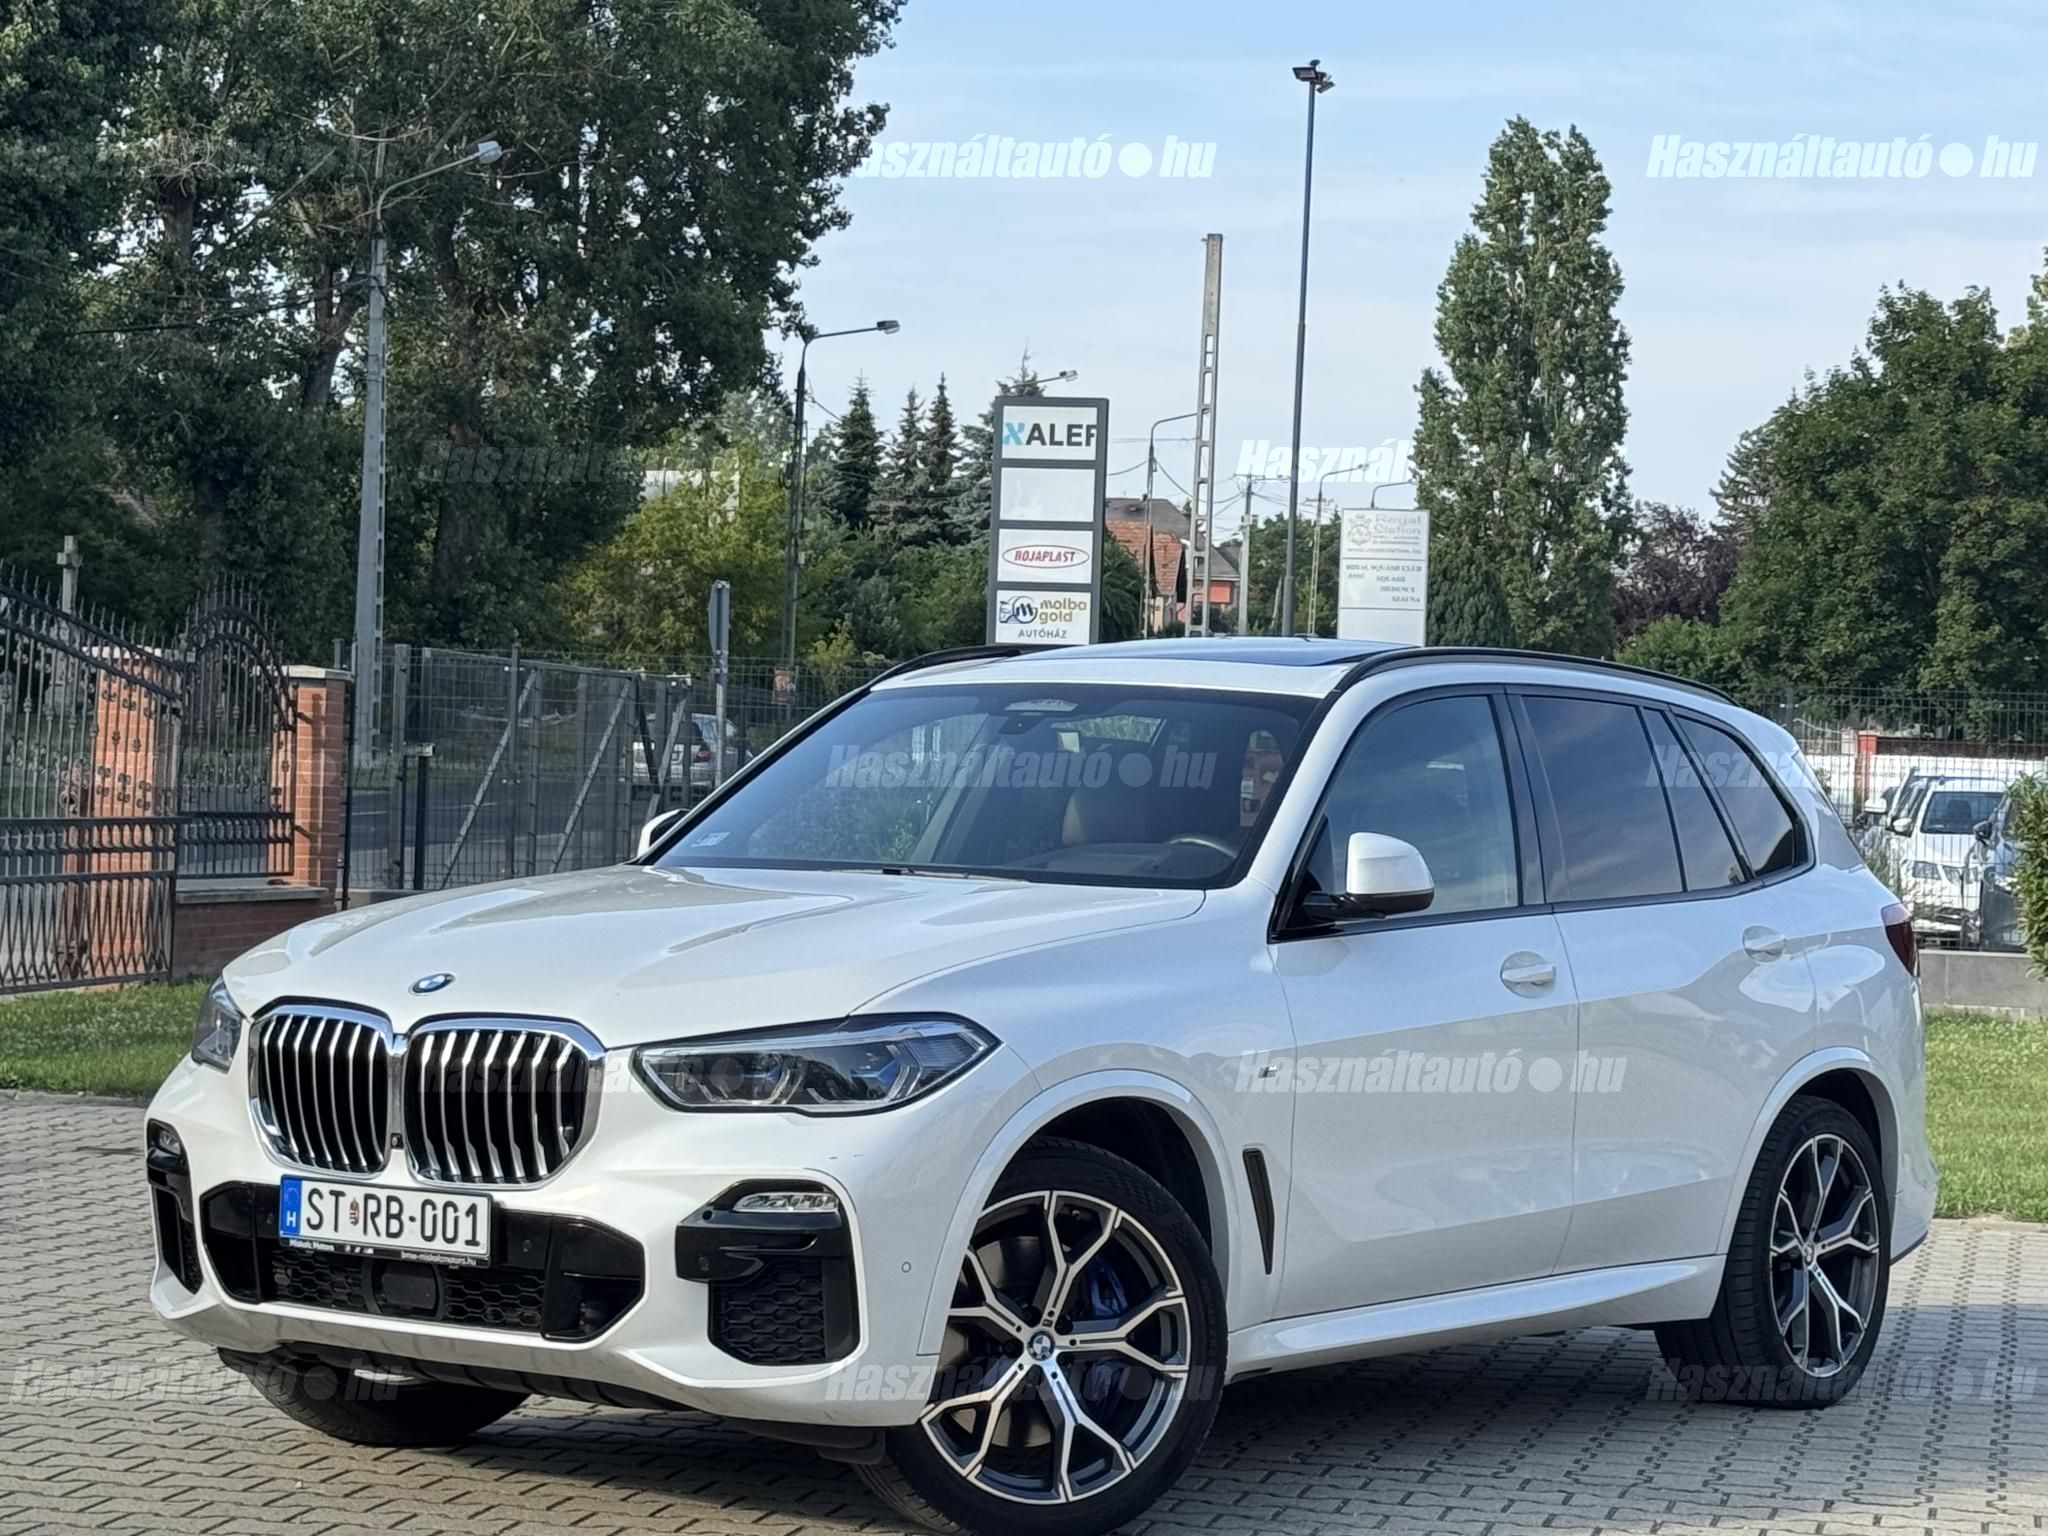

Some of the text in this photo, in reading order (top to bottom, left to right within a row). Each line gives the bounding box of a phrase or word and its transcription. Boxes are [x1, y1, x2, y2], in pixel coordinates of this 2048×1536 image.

[1039, 610, 1073, 625] gold
[1018, 627, 1067, 639] AUTÓHÁZ
[286, 1211, 297, 1228] H
